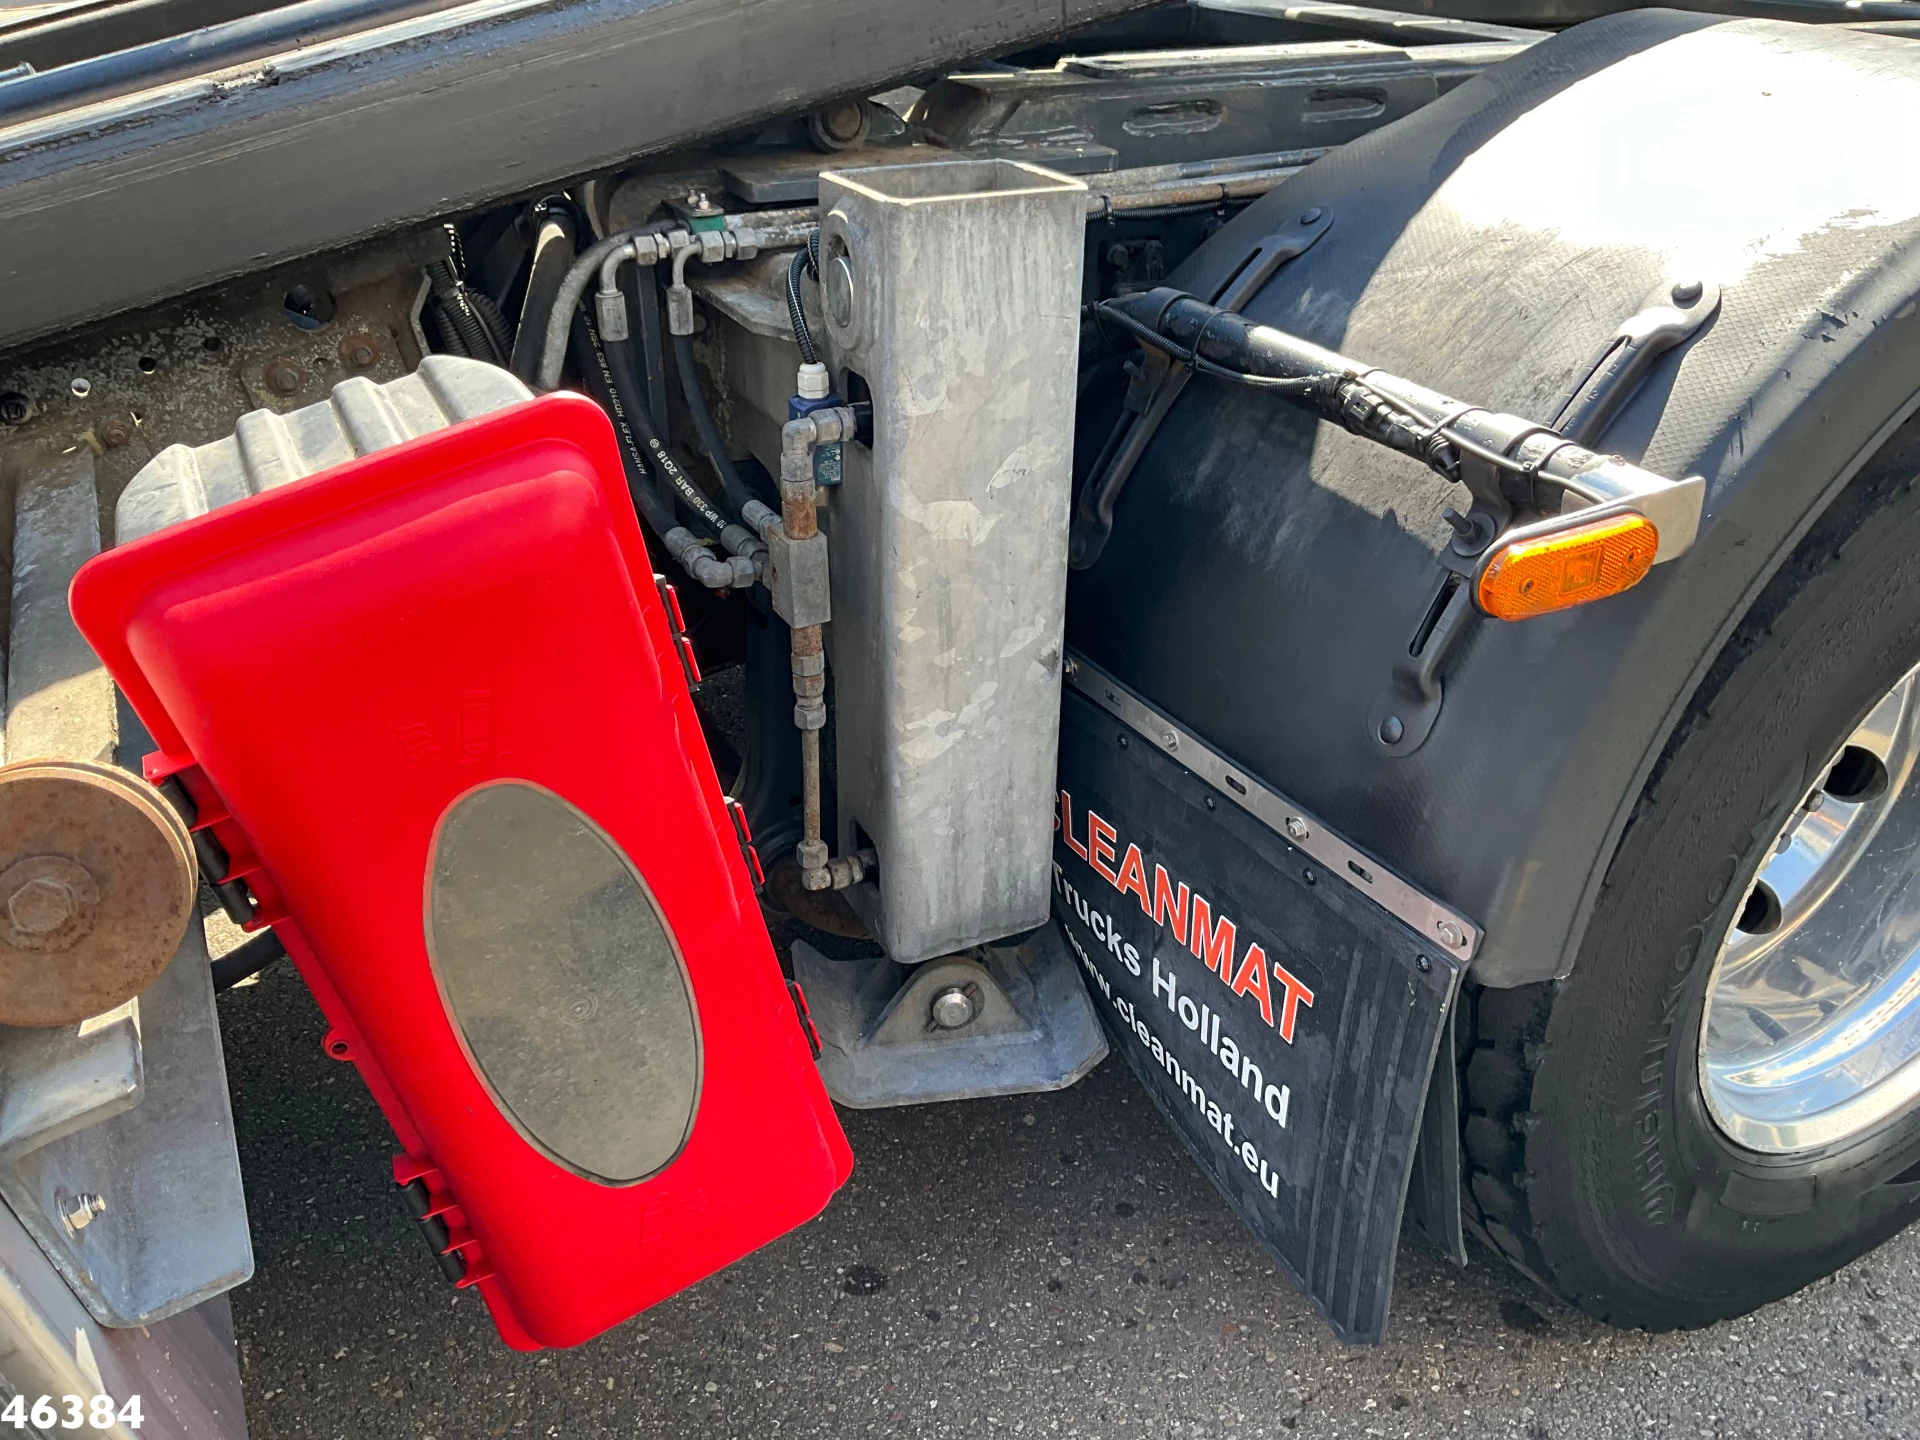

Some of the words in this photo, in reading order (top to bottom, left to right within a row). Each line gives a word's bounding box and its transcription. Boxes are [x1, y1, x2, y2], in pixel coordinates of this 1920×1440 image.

[602, 370, 614, 384] EN
[609, 388, 625, 417] HD210
[620, 421, 648, 475] HANSA-FLEX
[657, 450, 679, 475] 2Q18
[675, 475, 695, 497] BAR
[693, 497, 708, 511] 330
[705, 509, 720, 525] WP
[717, 519, 727, 529] 10
[1053, 788, 1314, 1045] LEANMAT
[1052, 857, 1141, 977] Trucks
[1152, 957, 1291, 1129] Holland
